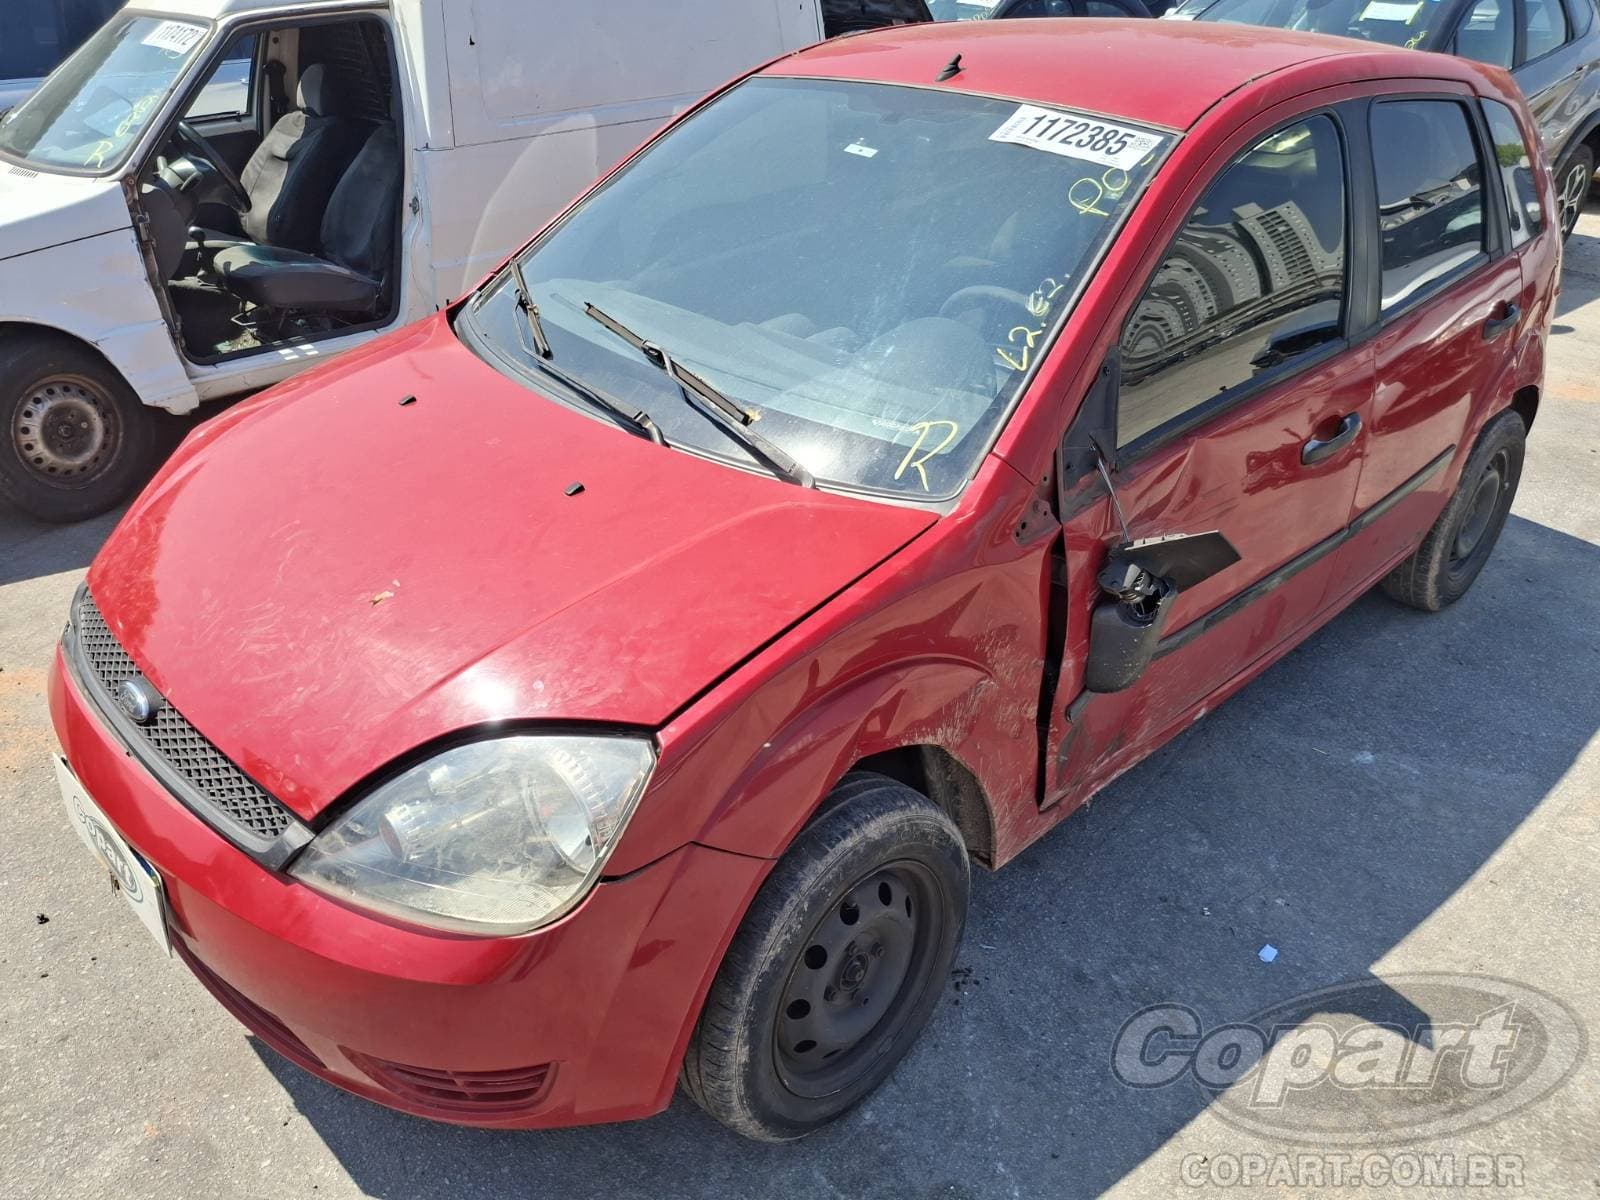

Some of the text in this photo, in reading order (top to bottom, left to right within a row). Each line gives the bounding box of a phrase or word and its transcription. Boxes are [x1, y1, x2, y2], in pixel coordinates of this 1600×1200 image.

[1023, 114, 1136, 156] 1172385
[895, 420, 958, 491] R
[73, 795, 135, 889] Copart
